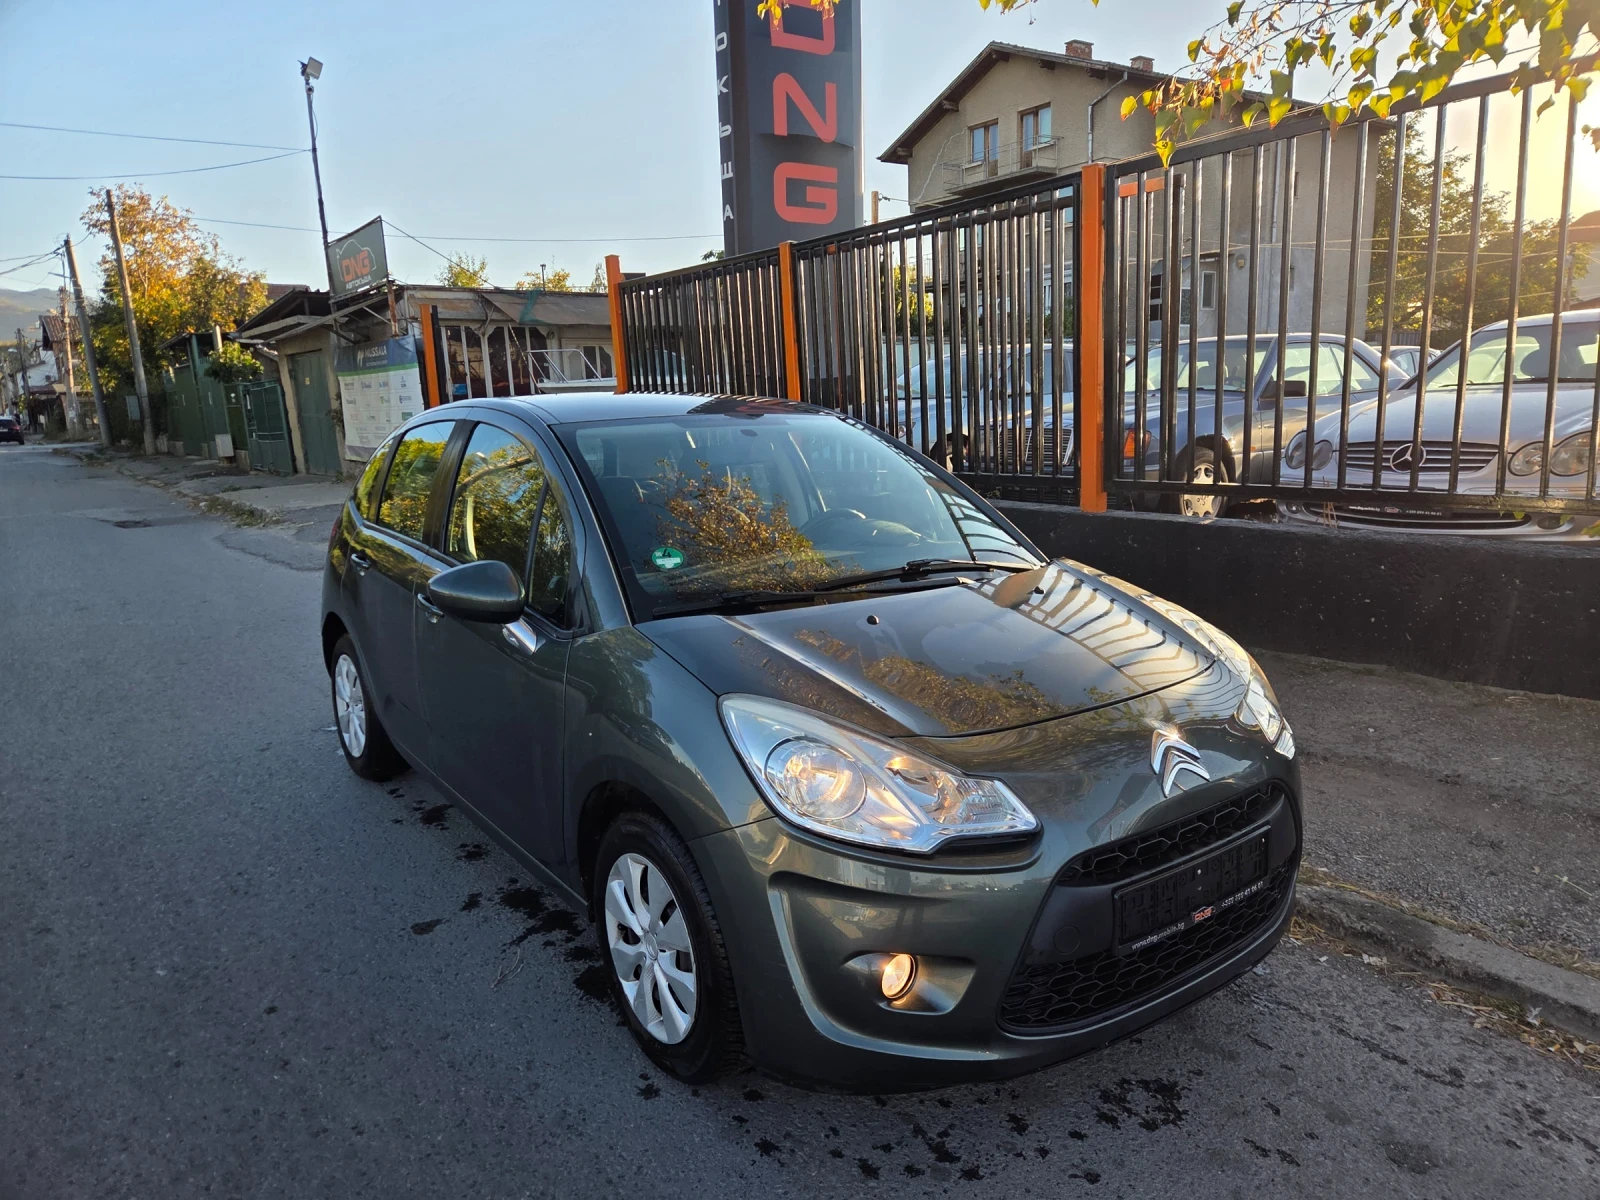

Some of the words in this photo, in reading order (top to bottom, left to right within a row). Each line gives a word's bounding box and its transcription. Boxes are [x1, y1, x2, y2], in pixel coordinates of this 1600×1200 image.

[715, 0, 734, 221] ОКЪЩА
[769, 0, 837, 224] DNG
[341, 249, 370, 283] DNG
